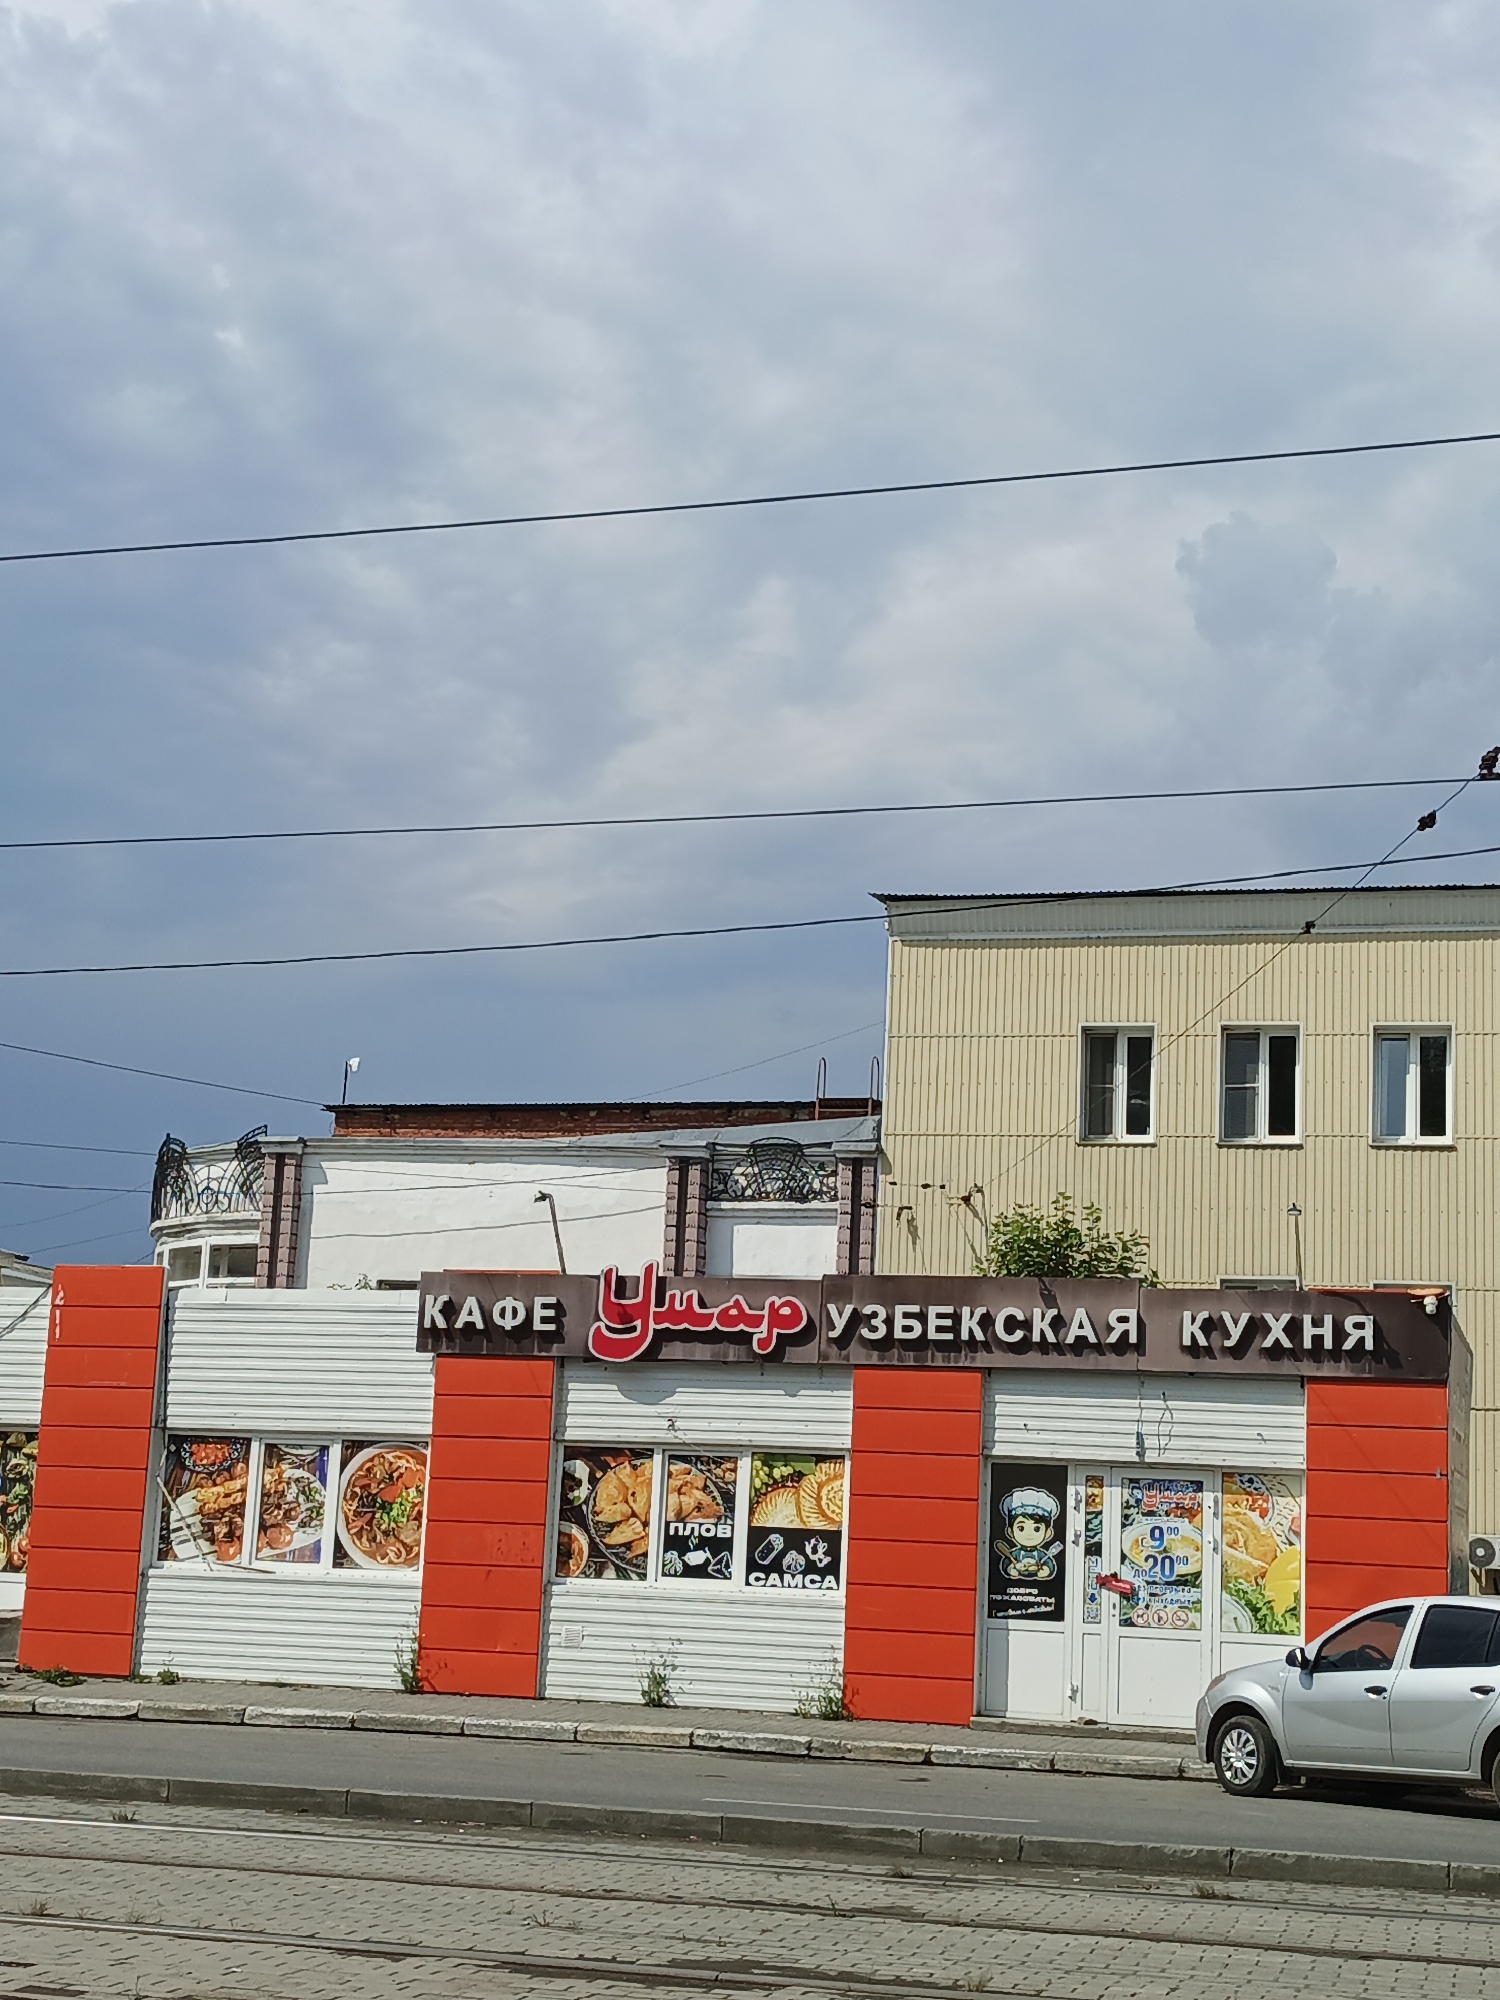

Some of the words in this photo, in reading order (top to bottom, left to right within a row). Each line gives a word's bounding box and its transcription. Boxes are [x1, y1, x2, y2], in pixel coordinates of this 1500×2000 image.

[423, 1294, 558, 1331] КАФЕ
[588, 1259, 808, 1363] Умар
[827, 1303, 1140, 1346] УЗБЕКСКАЯ
[1181, 1310, 1375, 1352] КУХНЯ
[668, 1522, 732, 1538] ПЛОВ
[748, 1571, 839, 1590] САМСА
